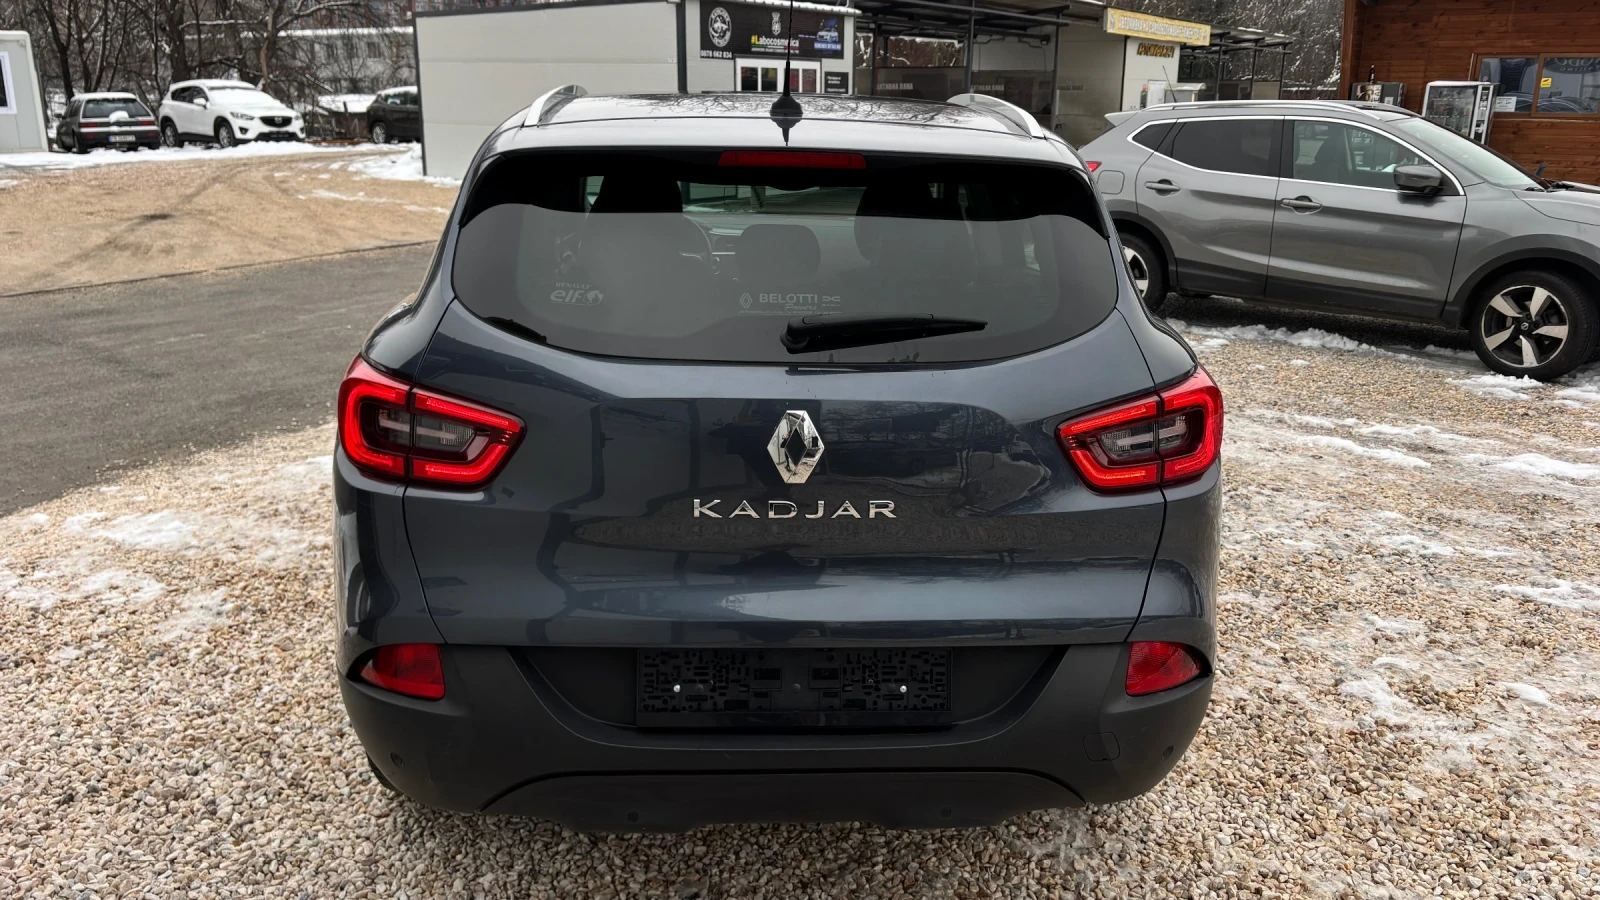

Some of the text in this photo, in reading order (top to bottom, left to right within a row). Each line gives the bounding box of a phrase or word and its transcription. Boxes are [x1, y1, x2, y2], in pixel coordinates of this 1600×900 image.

[751, 34, 799, 47] #Labocosmeica
[759, 293, 818, 304] BELOTTI
[693, 498, 897, 519] KADJAR
